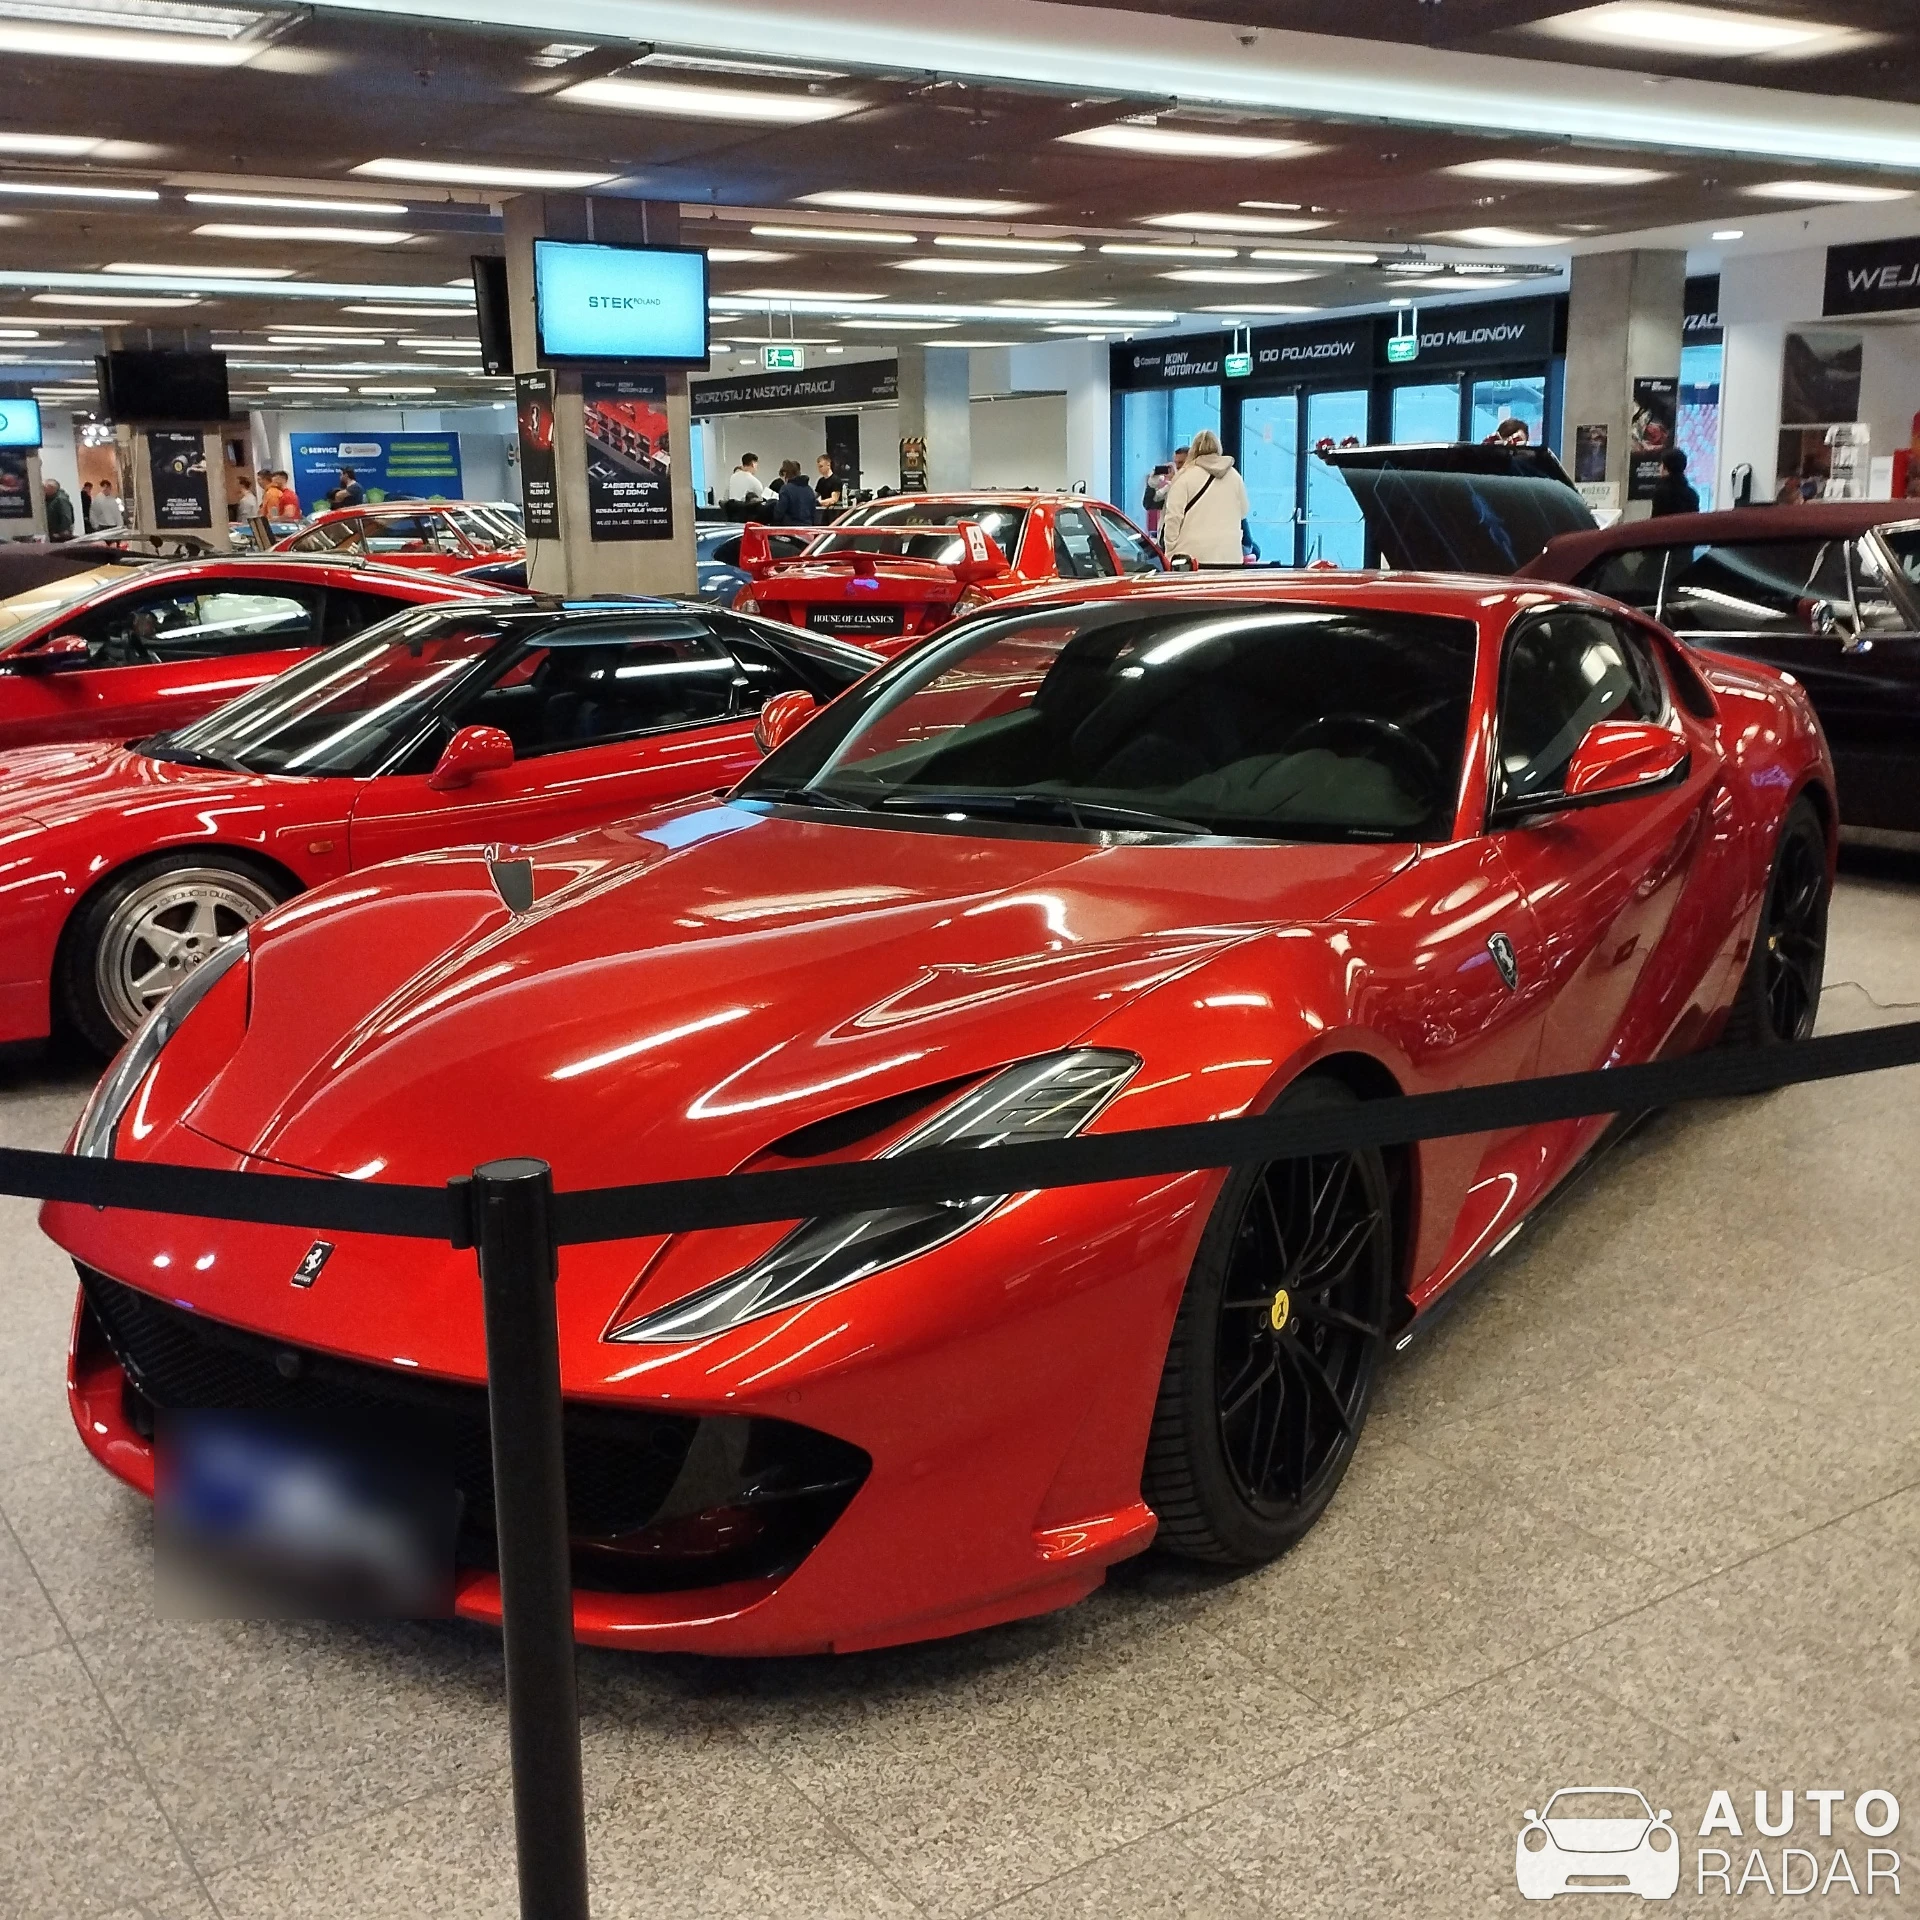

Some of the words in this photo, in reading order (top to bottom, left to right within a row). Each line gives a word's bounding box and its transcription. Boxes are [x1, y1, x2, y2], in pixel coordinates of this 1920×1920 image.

[1847, 263, 1920, 291] WEJ
[589, 296, 634, 309] STEK
[633, 298, 661, 306] POLAND
[1421, 333, 1444, 347] 100
[1446, 323, 1526, 345] MILIONÓW
[1165, 352, 1188, 365] IKONY
[1259, 349, 1279, 362] 100
[1281, 341, 1356, 361] POJAZDÓW
[1164, 361, 1219, 377] MOTORYZACJI
[694, 389, 744, 405] SKORZYSTAJ
[745, 388, 751, 400] Z
[753, 384, 792, 399] NASZYCH
[793, 380, 836, 396] ATRAKCJI
[602, 482, 635, 490] ZABIERZ
[636, 482, 659, 490] IKONĘ
[813, 614, 841, 623] HOUSE
[841, 615, 854, 623] OF
[854, 615, 894, 624] CLASSICS
